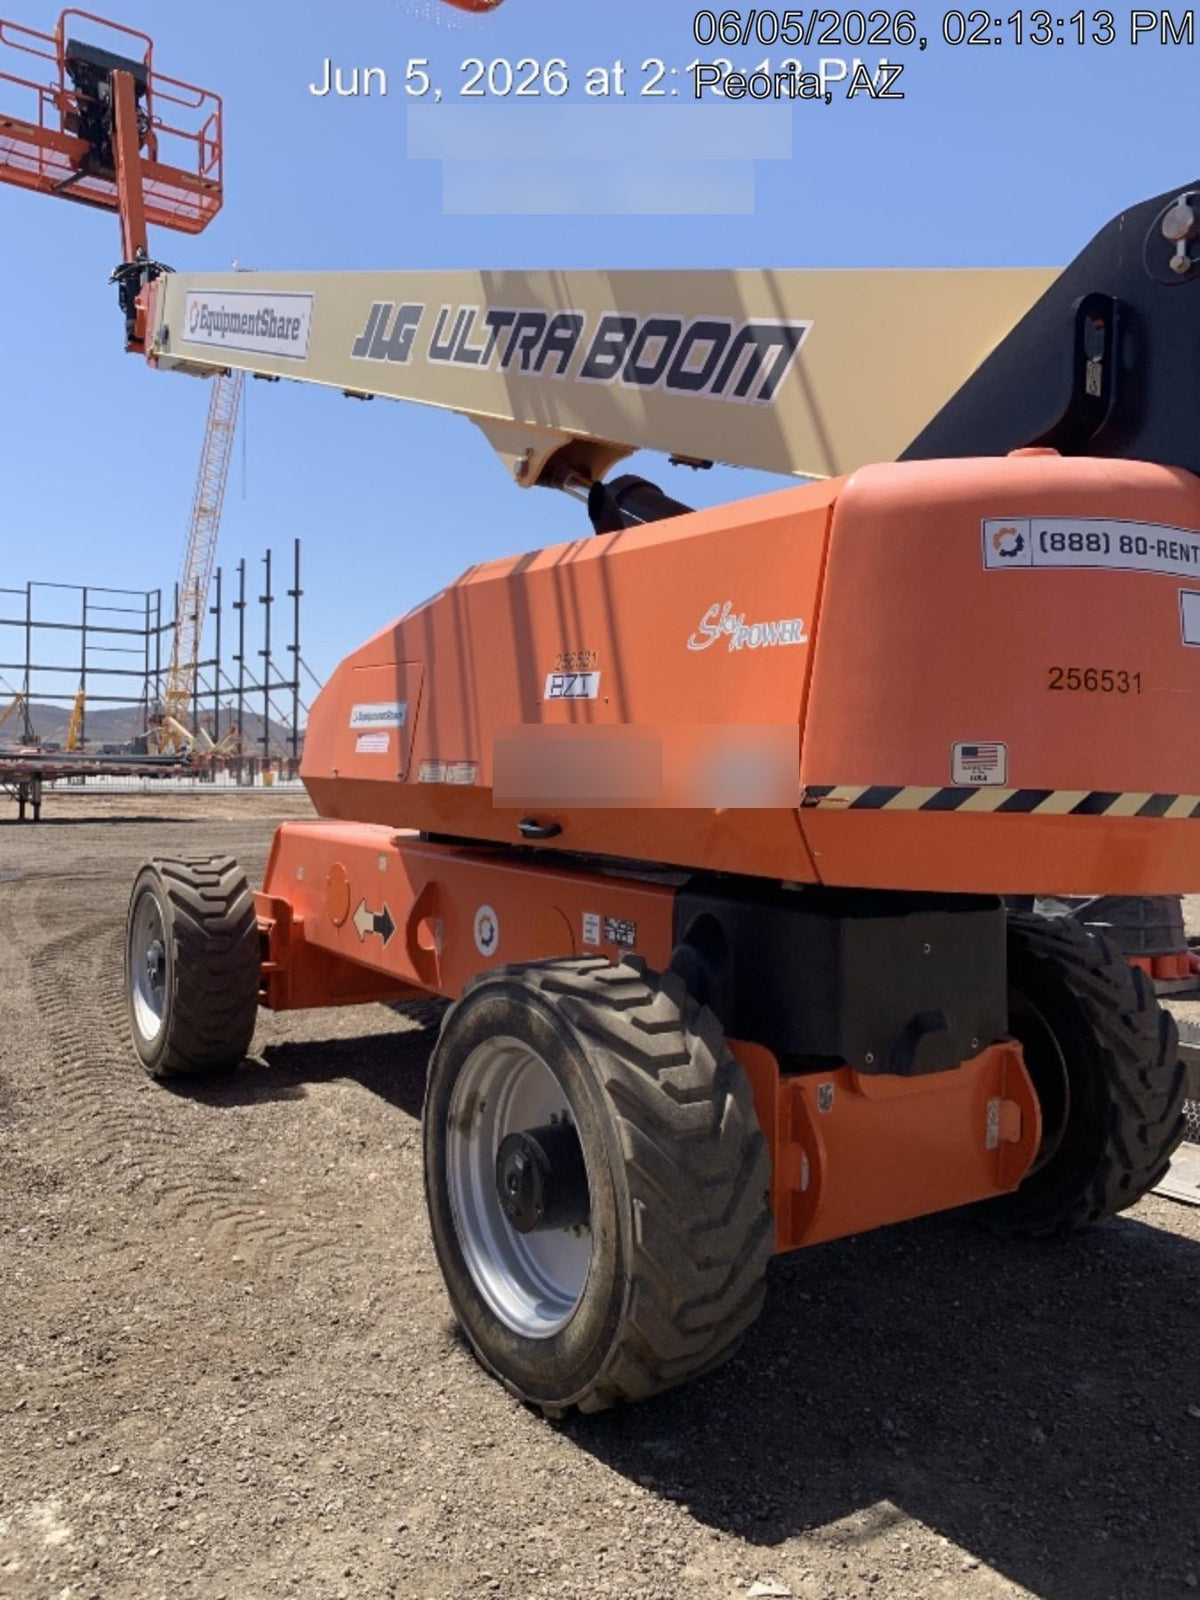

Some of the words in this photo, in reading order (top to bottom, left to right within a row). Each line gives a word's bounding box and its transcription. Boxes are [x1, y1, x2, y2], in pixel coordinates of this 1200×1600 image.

[199, 304, 301, 341] EquipmentShare
[352, 302, 424, 363] JLG
[429, 307, 585, 376] ULTRA
[579, 314, 808, 402] BOOM
[1039, 530, 1110, 555] (888)
[1048, 666, 1142, 694] 256531
